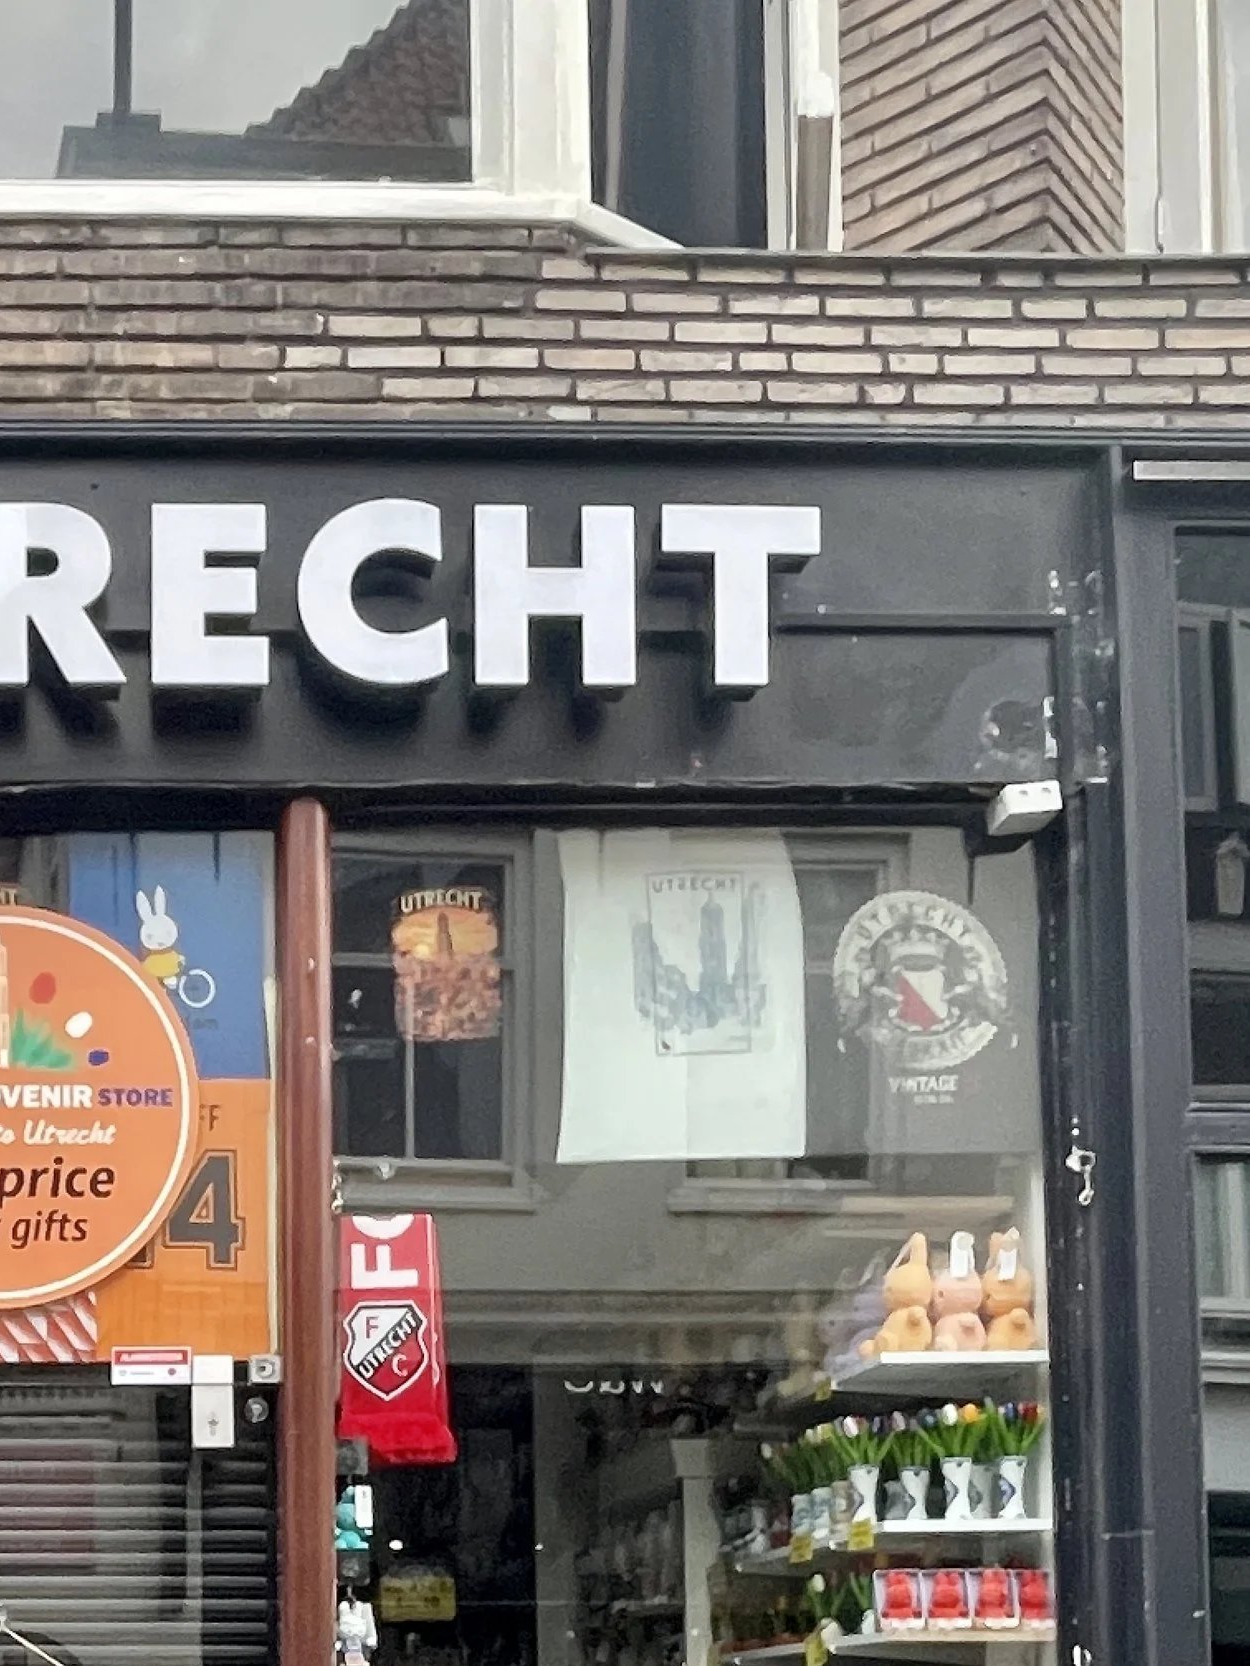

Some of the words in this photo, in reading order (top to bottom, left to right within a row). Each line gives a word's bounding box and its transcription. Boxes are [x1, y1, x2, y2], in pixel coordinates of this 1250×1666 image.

[651, 876, 736, 893] UTRECHT
[400, 888, 483, 913] UTRECHT
[887, 1075, 959, 1094] VINTAGE
[97, 1087, 174, 1107] STORE
[23, 1119, 117, 1146] Utrecht
[10, 1210, 88, 1250] gifts
[365, 1316, 380, 1340] F
[358, 1311, 419, 1380] UTRECHT
[392, 1354, 409, 1377] C
